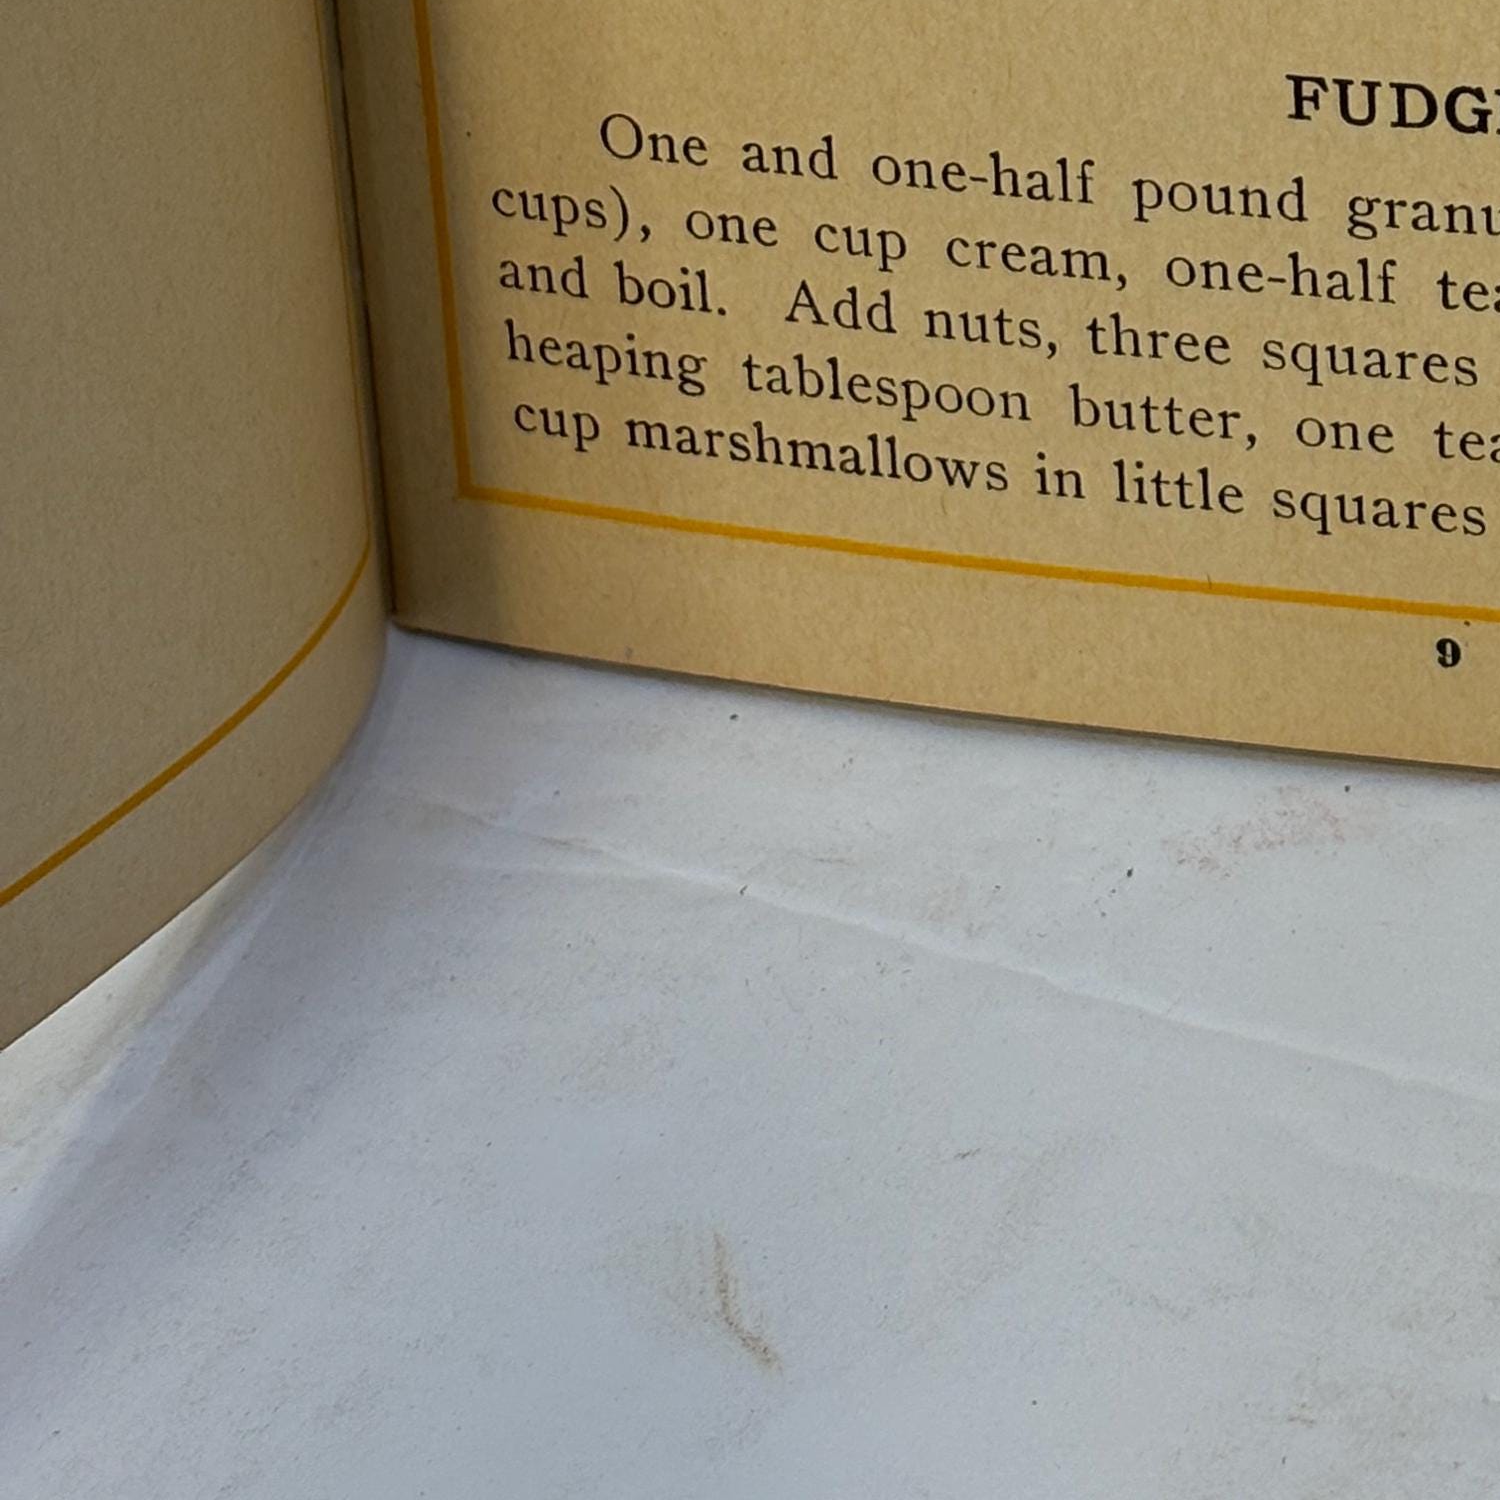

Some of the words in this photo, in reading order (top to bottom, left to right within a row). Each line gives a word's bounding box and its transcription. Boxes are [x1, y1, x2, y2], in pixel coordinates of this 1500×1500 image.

[599, 113, 708, 167] One
[741, 134, 839, 181] and
[872, 150, 1095, 205] one-half
[1131, 175, 1309, 224] pound
[491, 185, 651, 244] cups),
[685, 210, 778, 248] one
[814, 223, 907, 274] cup
[945, 237, 1127, 292] cream,
[1165, 250, 1398, 305] one-half
[499, 254, 589, 299] and
[613, 259, 727, 317] boil.
[784, 279, 898, 334] Add
[923, 307, 1057, 360] nuts,
[1085, 311, 1232, 366] three
[1262, 339, 1478, 387] squares
[504, 318, 708, 398] heaping
[741, 353, 1032, 423] tablespoon
[1068, 382, 1257, 452] butter,
[1295, 417, 1395, 454] one
[514, 404, 600, 453] cup
[624, 418, 1009, 492] marshmallows
[1034, 451, 1086, 500] in
[1112, 458, 1244, 515] little
[1272, 489, 1486, 537] squares
[1435, 637, 1462, 669] 9
